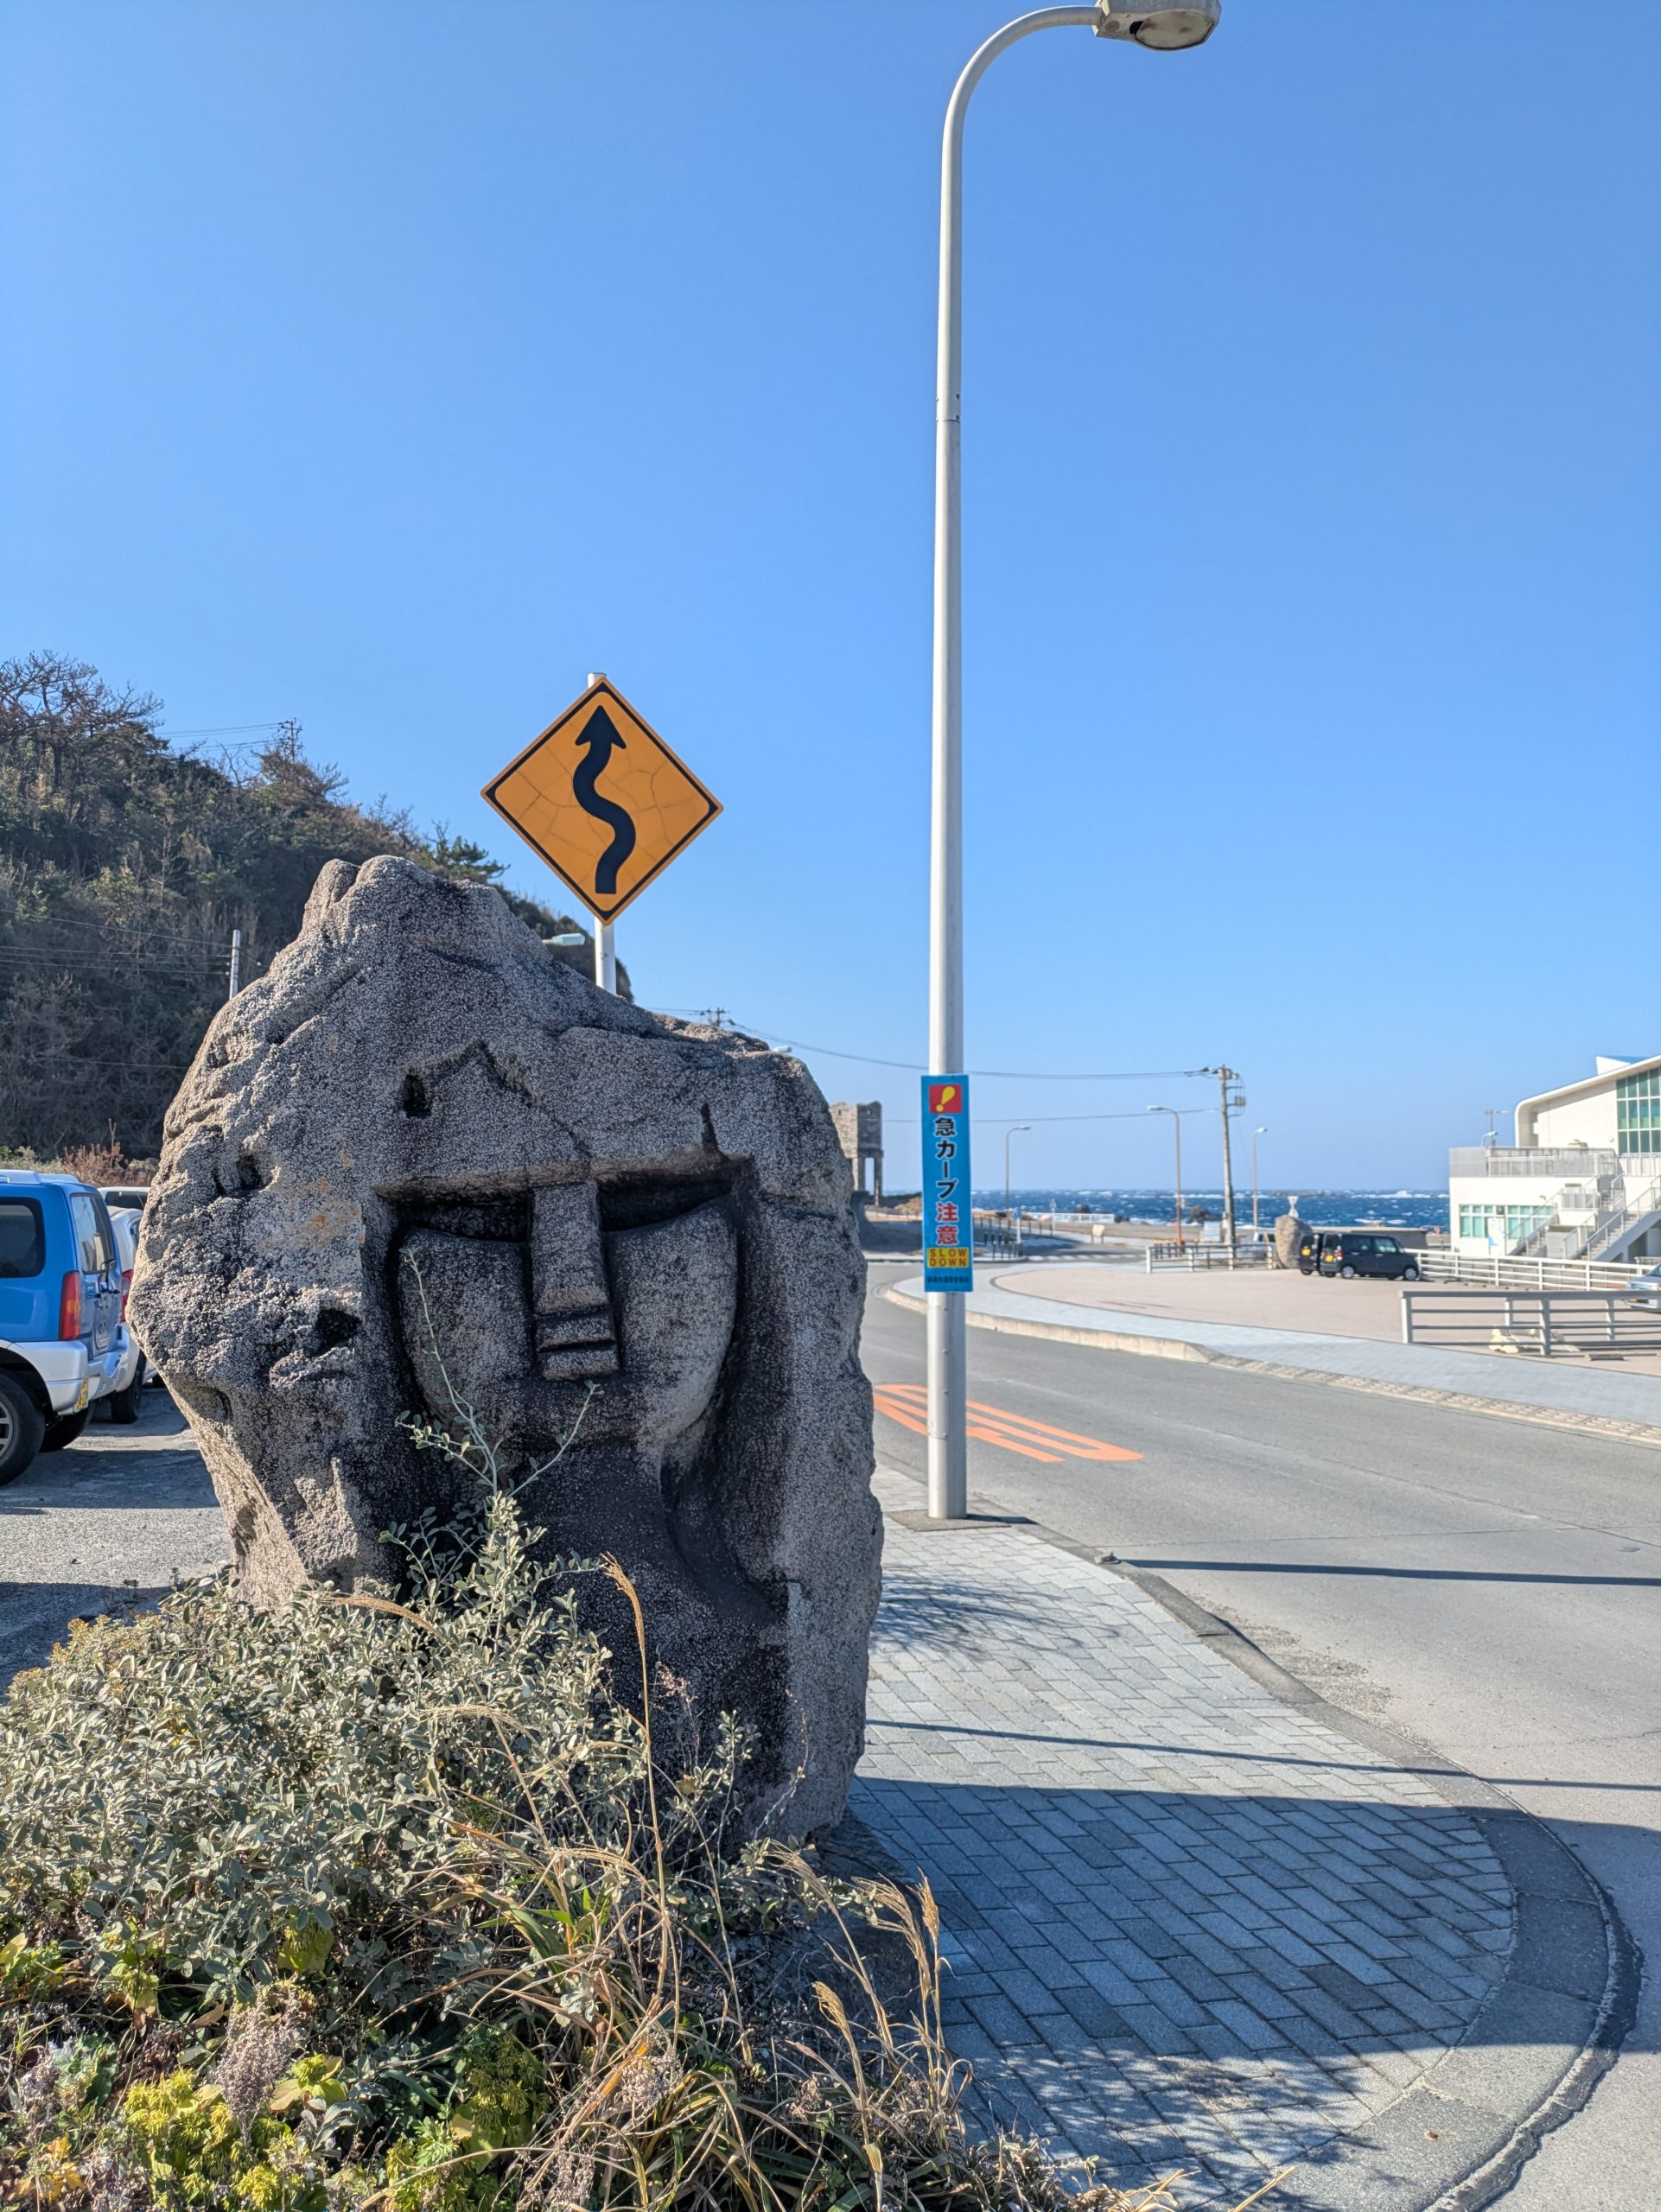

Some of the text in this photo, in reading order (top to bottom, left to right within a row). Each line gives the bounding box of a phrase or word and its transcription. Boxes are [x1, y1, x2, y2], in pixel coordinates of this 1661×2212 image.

[934, 1116, 959, 1245] 急カーブ注意
[929, 1248, 967, 1257] SLOW
[929, 1257, 966, 1267] DOWN
